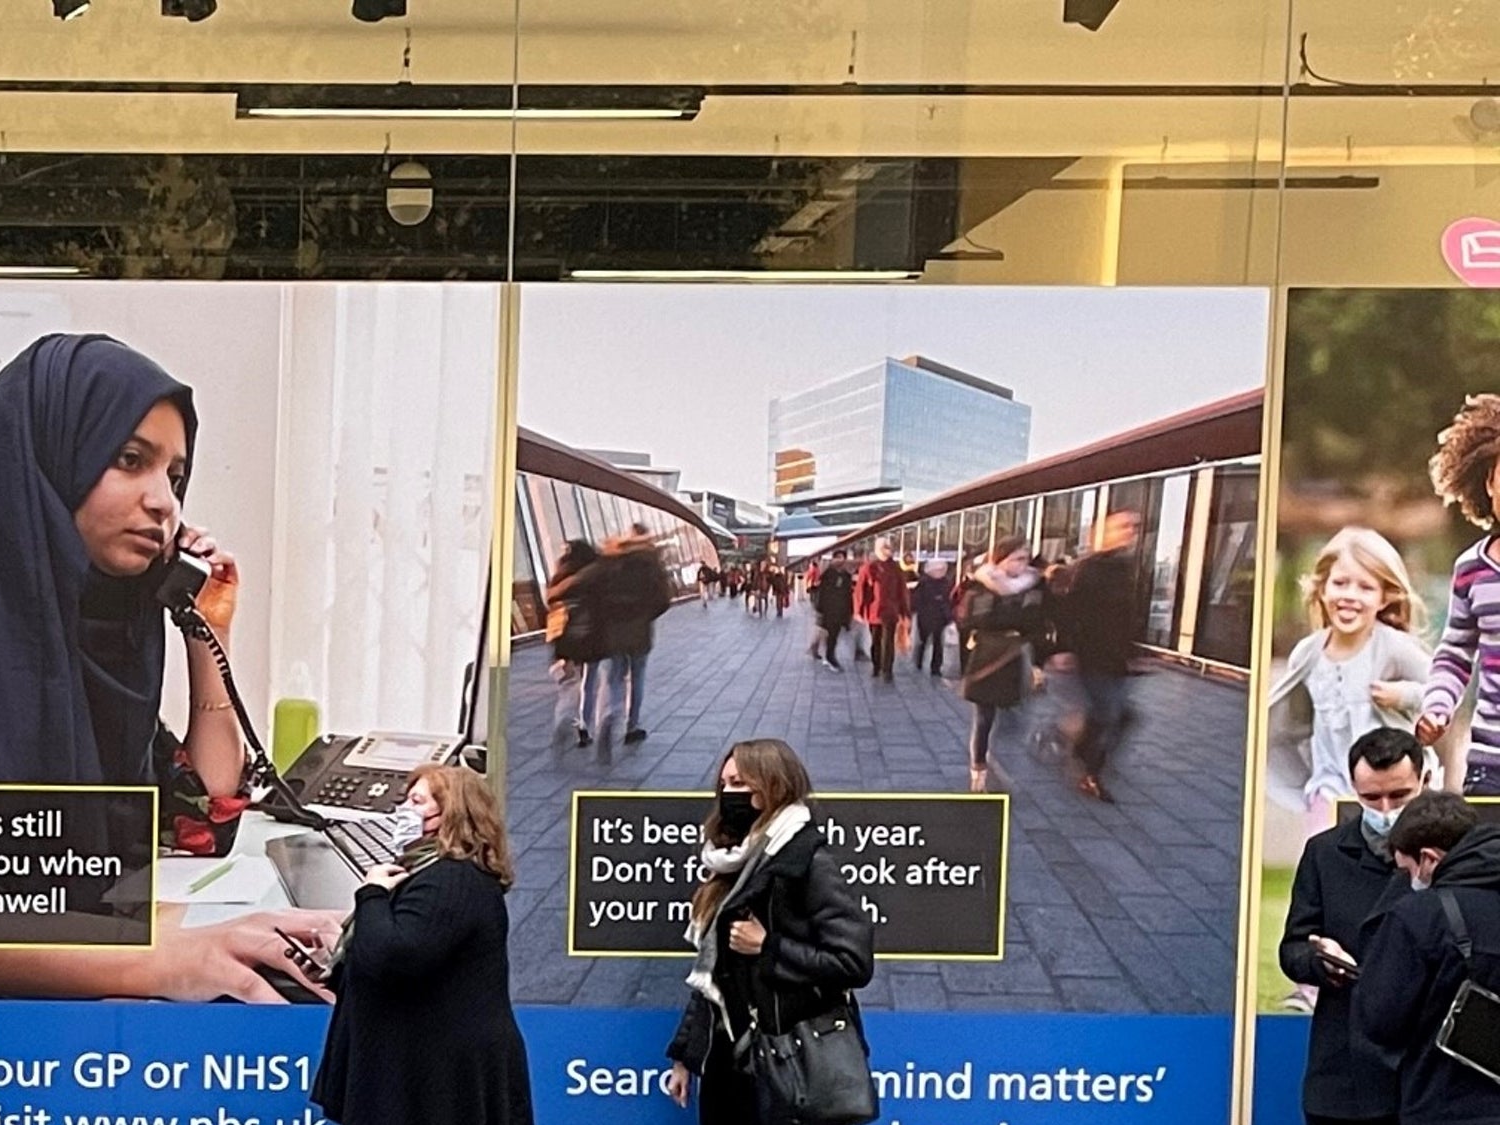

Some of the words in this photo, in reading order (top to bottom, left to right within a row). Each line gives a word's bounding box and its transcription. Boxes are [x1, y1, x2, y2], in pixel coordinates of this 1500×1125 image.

[11, 810, 62, 837] still
[592, 818, 634, 844] It’s
[854, 825, 925, 853] year.
[39, 848, 121, 876] when
[592, 856, 675, 883] Don’t
[905, 857, 981, 885] after
[589, 901, 659, 927] your
[73, 1052, 131, 1088] GP
[143, 1061, 190, 1089] or
